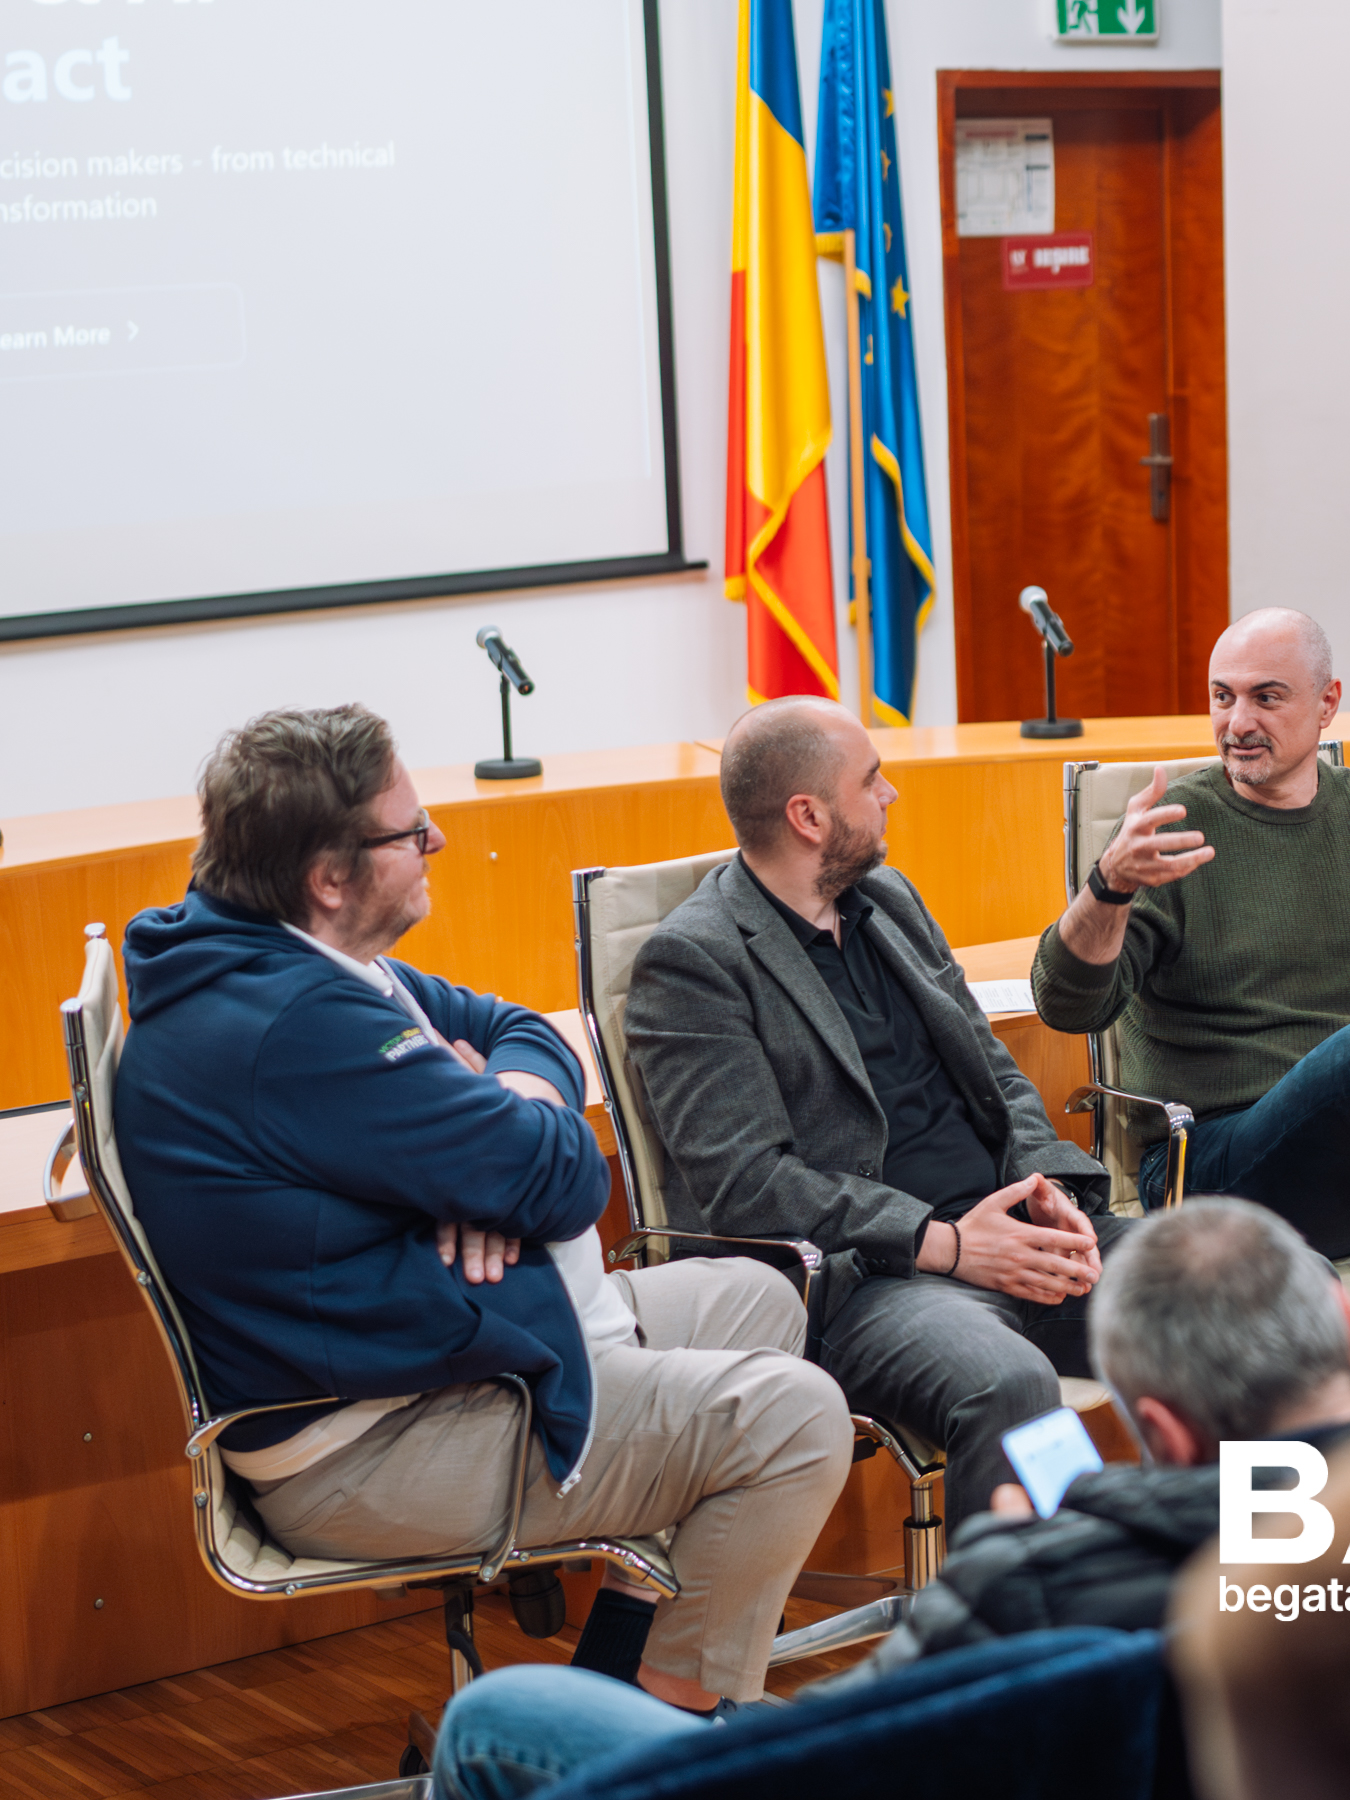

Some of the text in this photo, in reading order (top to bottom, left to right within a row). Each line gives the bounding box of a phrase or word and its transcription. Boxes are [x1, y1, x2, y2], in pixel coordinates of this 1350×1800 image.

[2, 35, 133, 104] act
[0, 150, 78, 180] cision
[87, 148, 183, 178] makers
[211, 144, 274, 173] from
[283, 140, 395, 170] technical
[53, 324, 111, 347] More
